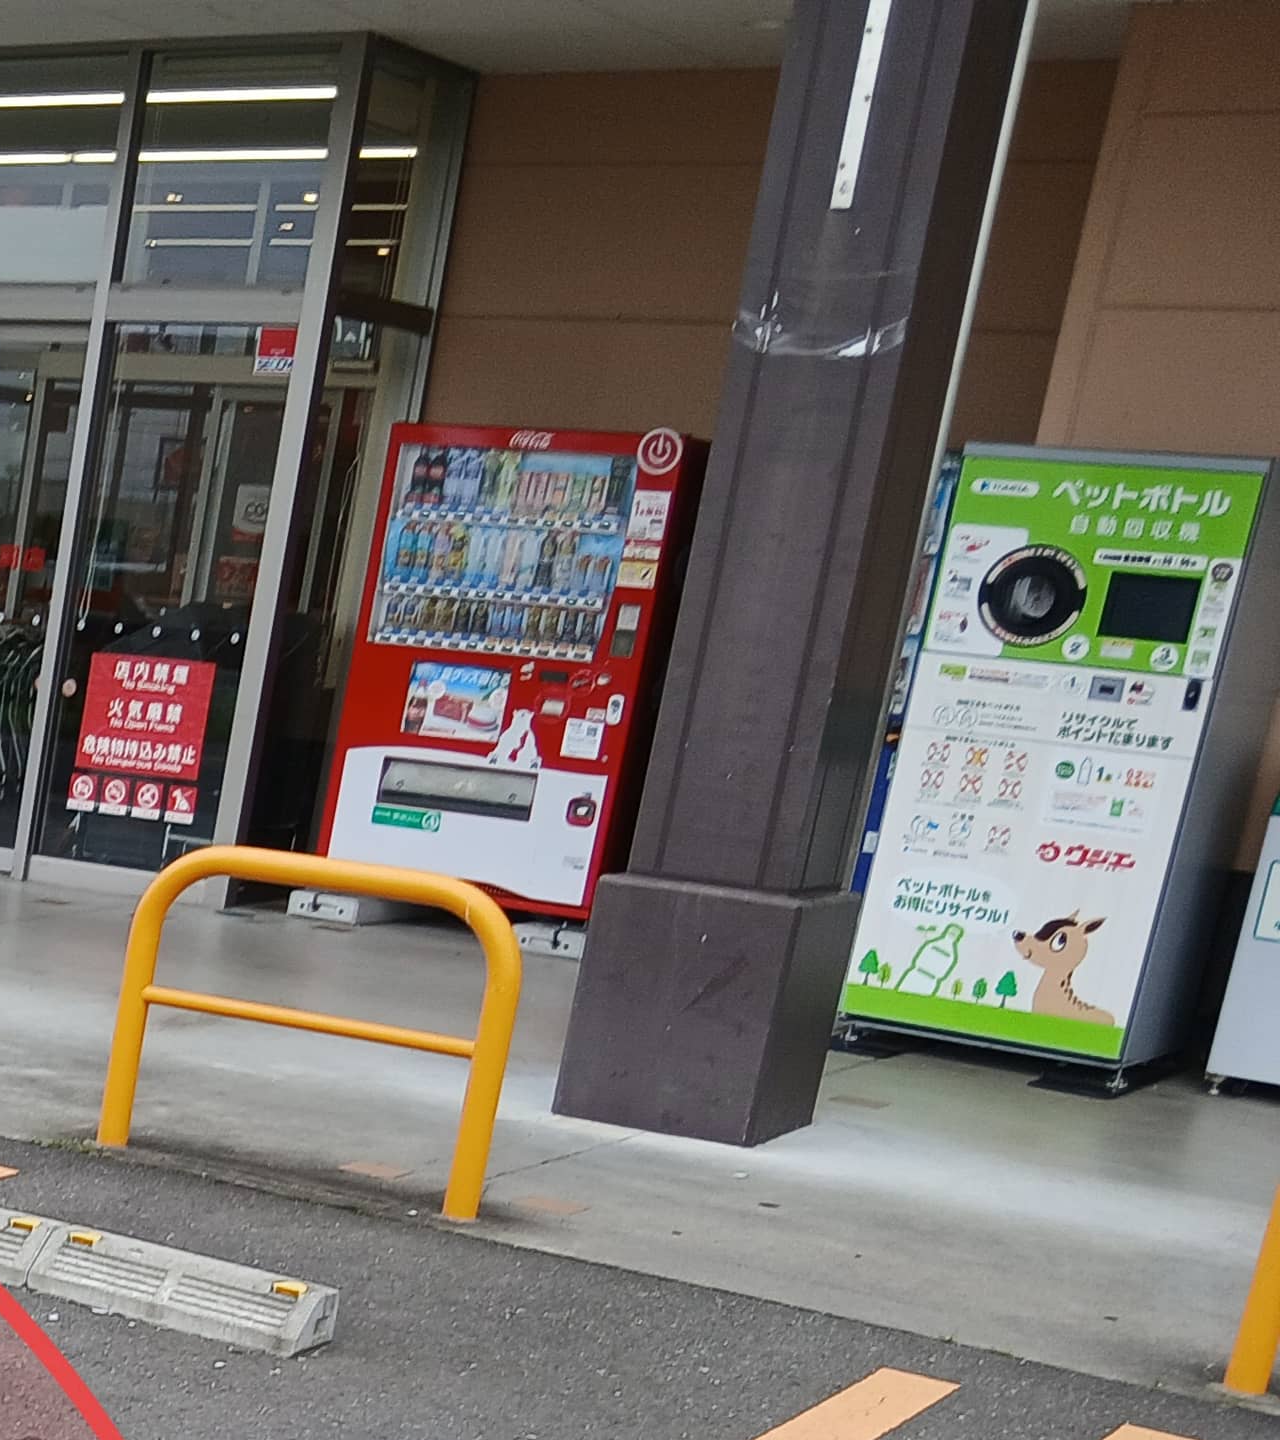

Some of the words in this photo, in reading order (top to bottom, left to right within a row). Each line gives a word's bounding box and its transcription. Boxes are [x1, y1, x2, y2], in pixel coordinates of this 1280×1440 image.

[1052, 480, 1232, 517] ペットボトル
[1069, 514, 1202, 543] 自動回収機
[114, 660, 190, 685] 店内禁煙
[107, 698, 184, 725] 火気厳禁
[1061, 711, 1139, 729] リサイクルで
[897, 878, 992, 902] ペットボトルを
